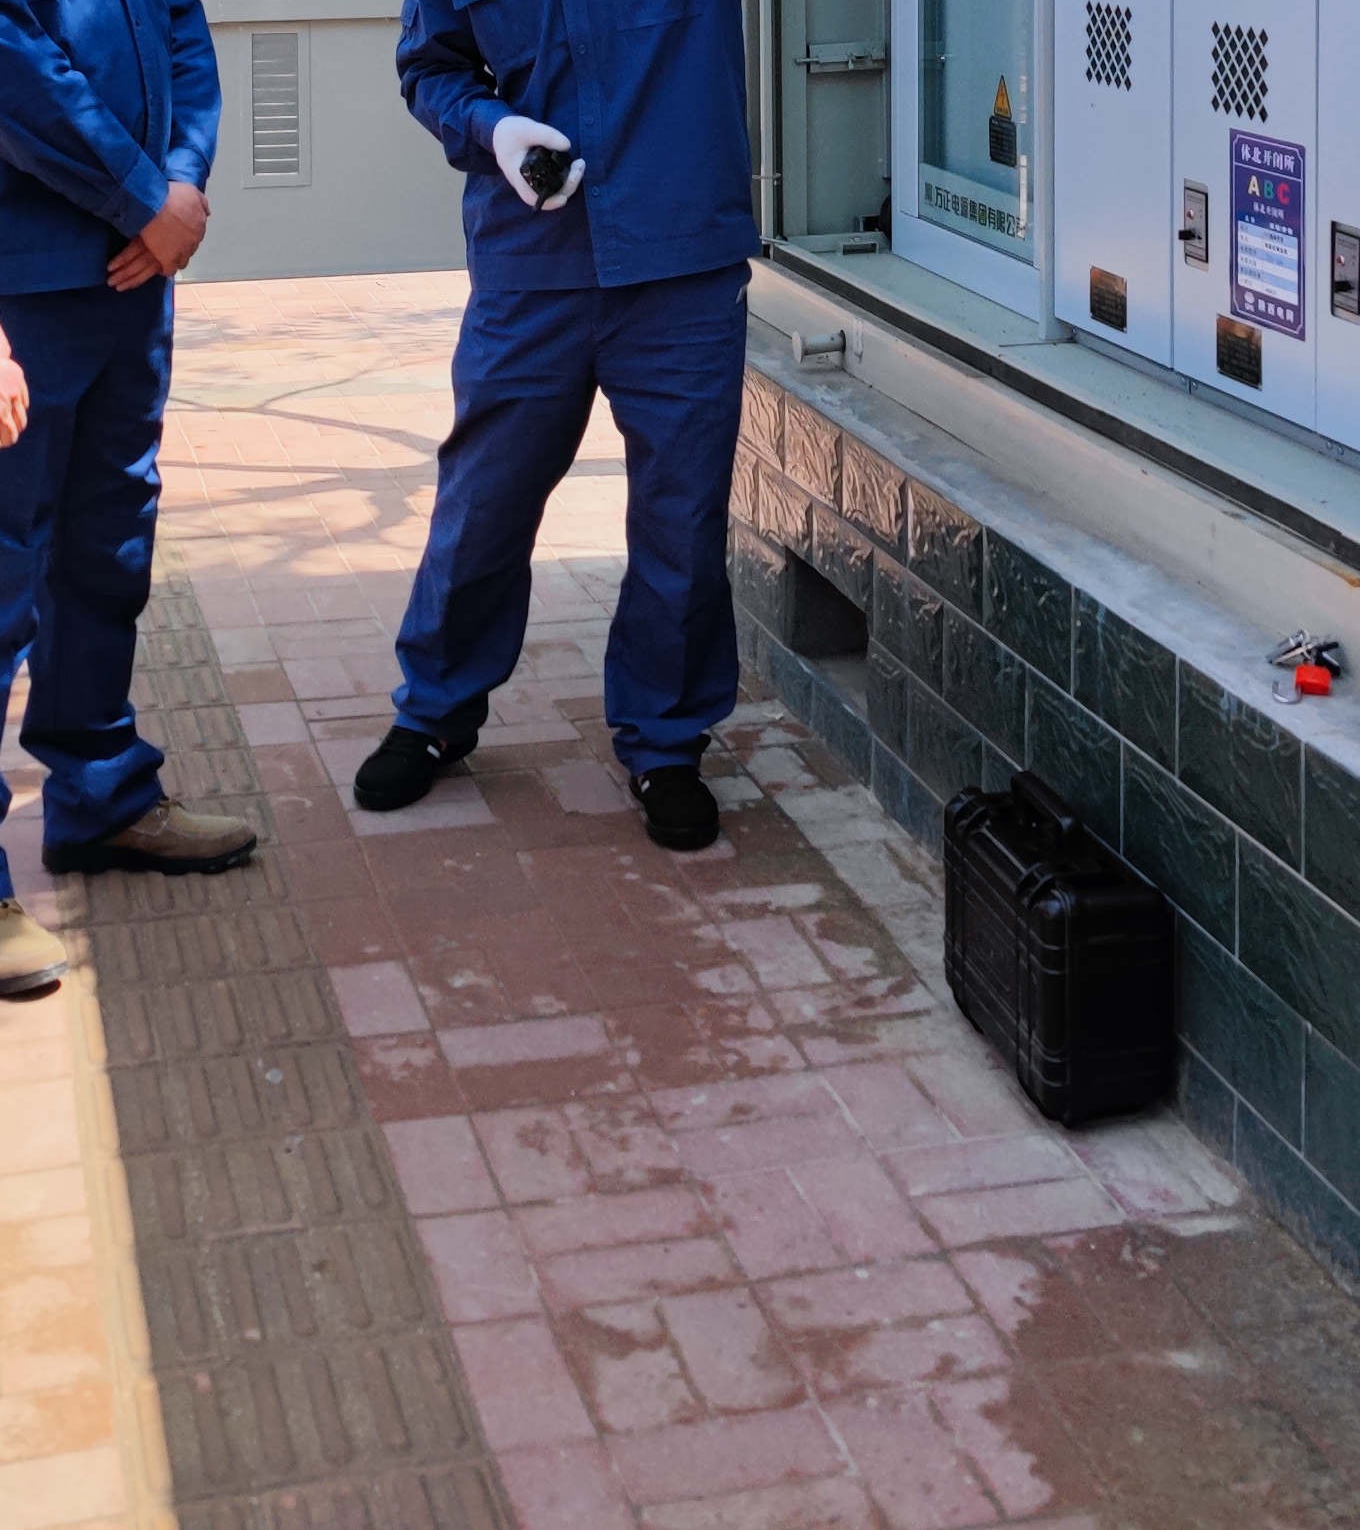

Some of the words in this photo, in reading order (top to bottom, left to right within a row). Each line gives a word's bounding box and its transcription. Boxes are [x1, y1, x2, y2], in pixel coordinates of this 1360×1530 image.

[1247, 175, 1260, 196] A
[1264, 180, 1274, 200] B
[1277, 183, 1289, 204] C
